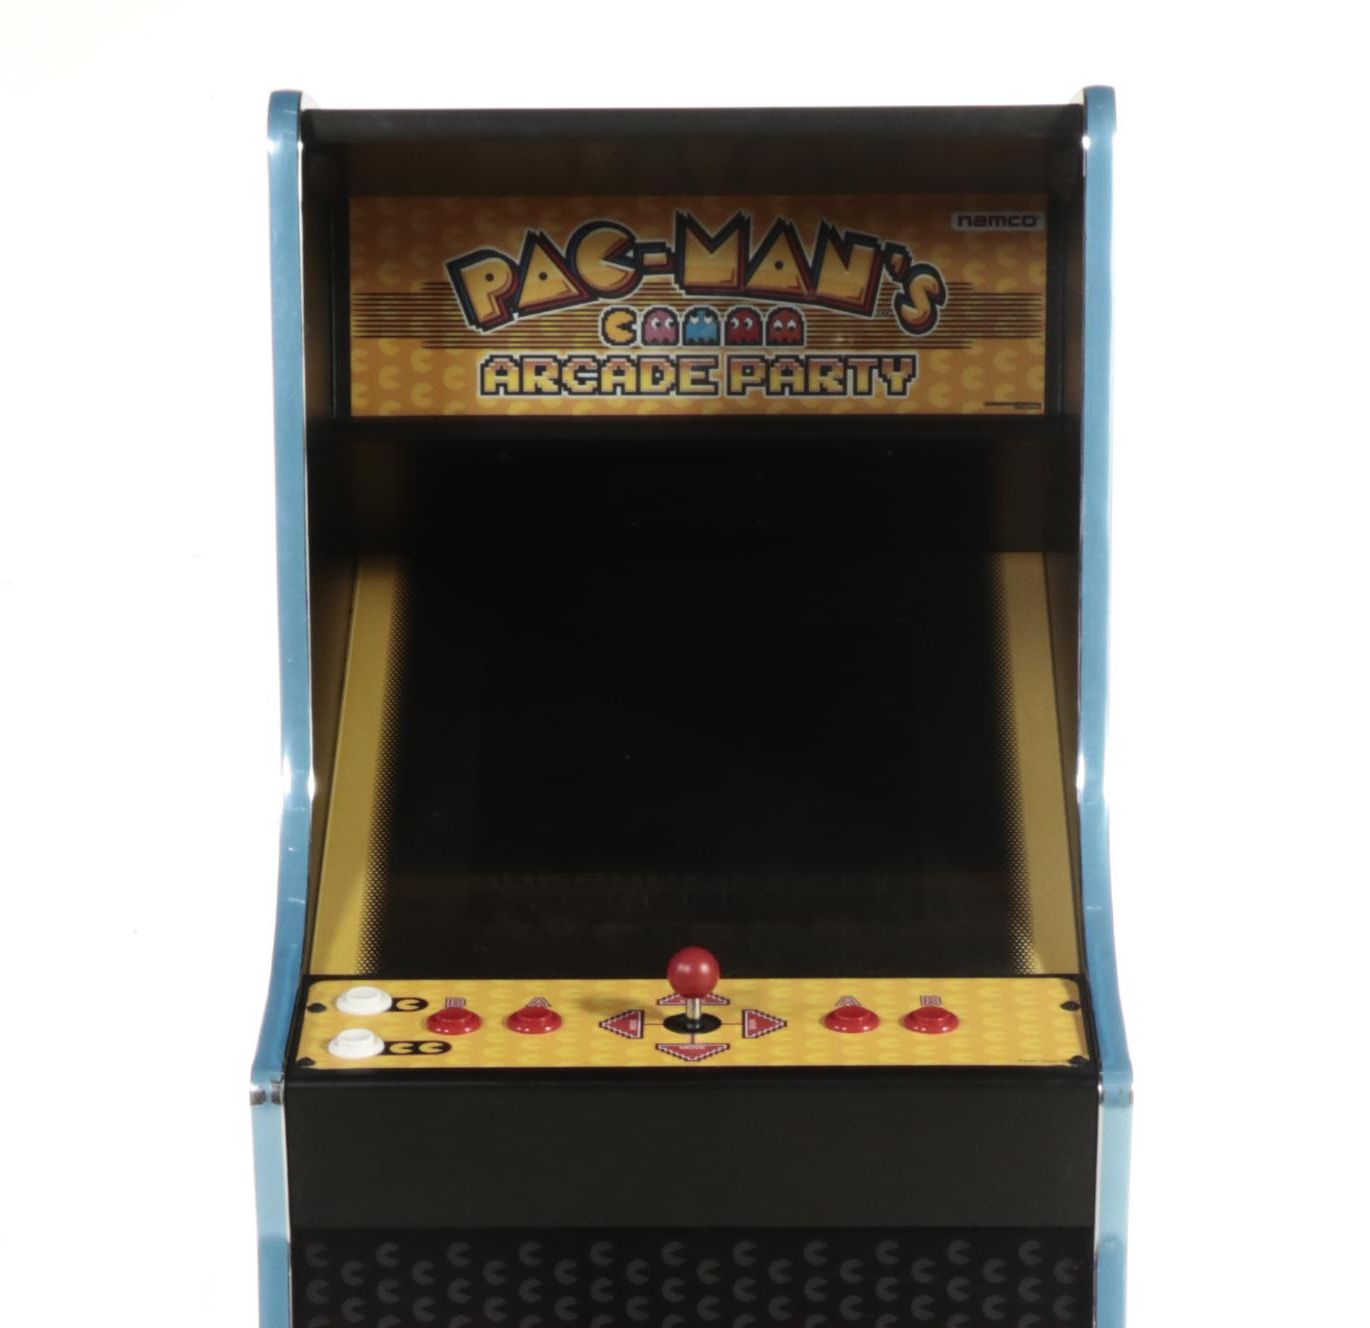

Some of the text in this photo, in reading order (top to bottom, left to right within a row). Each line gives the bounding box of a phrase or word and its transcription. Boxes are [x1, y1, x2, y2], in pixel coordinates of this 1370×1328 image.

[957, 214, 1037, 228] namco
[480, 353, 918, 397] ARCADE PARTY
